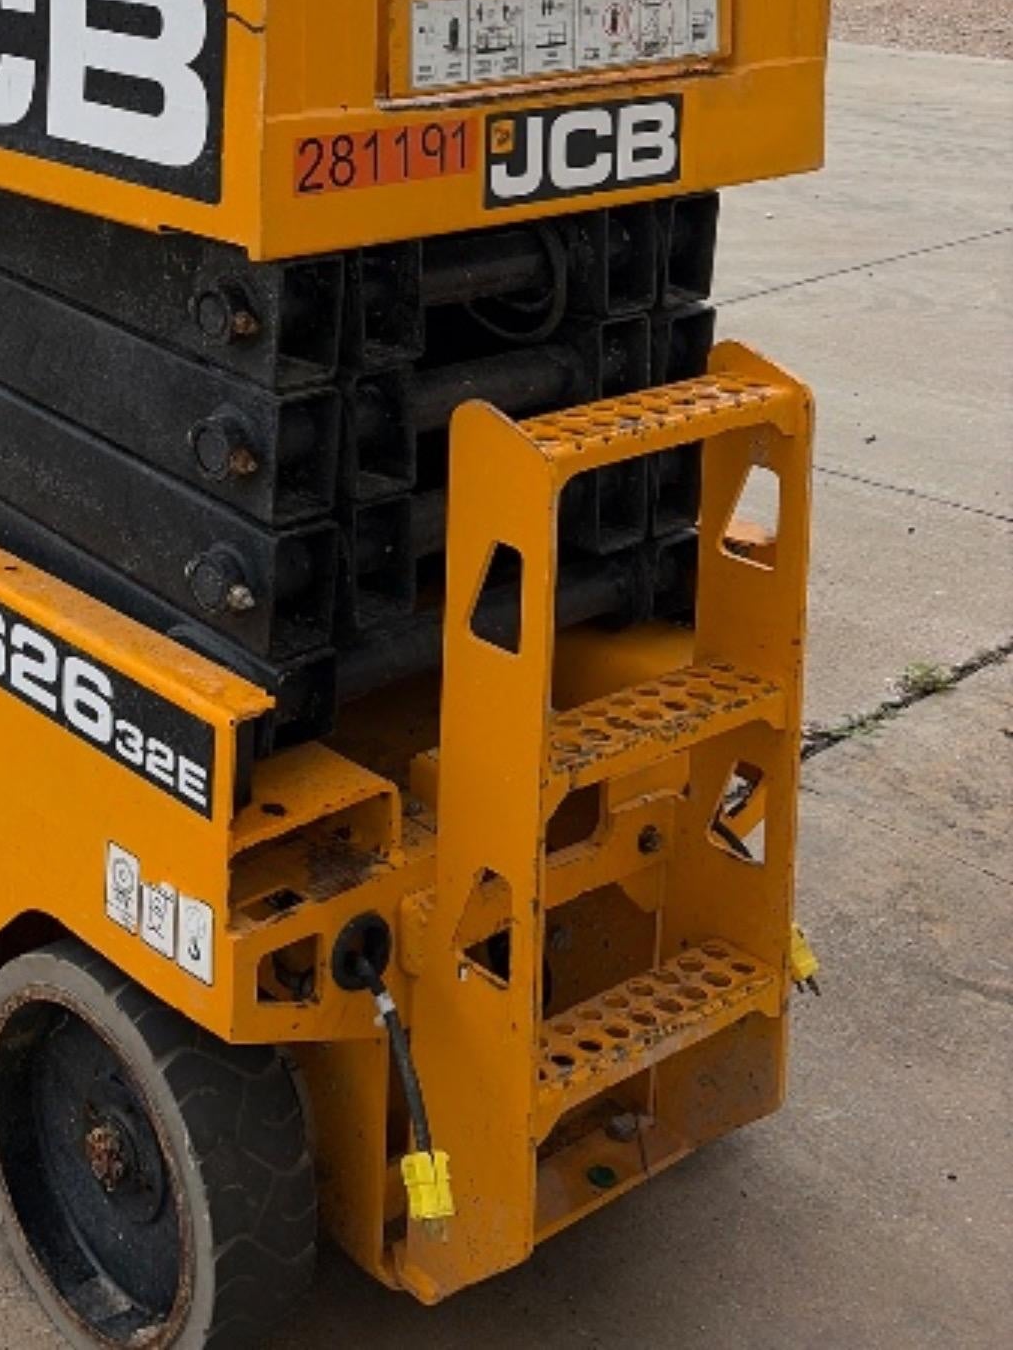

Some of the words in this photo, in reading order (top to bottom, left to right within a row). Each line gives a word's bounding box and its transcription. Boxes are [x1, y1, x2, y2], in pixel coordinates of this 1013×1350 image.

[297, 119, 469, 193] 281191
[490, 101, 678, 198] JCB
[114, 719, 208, 808] 32E
